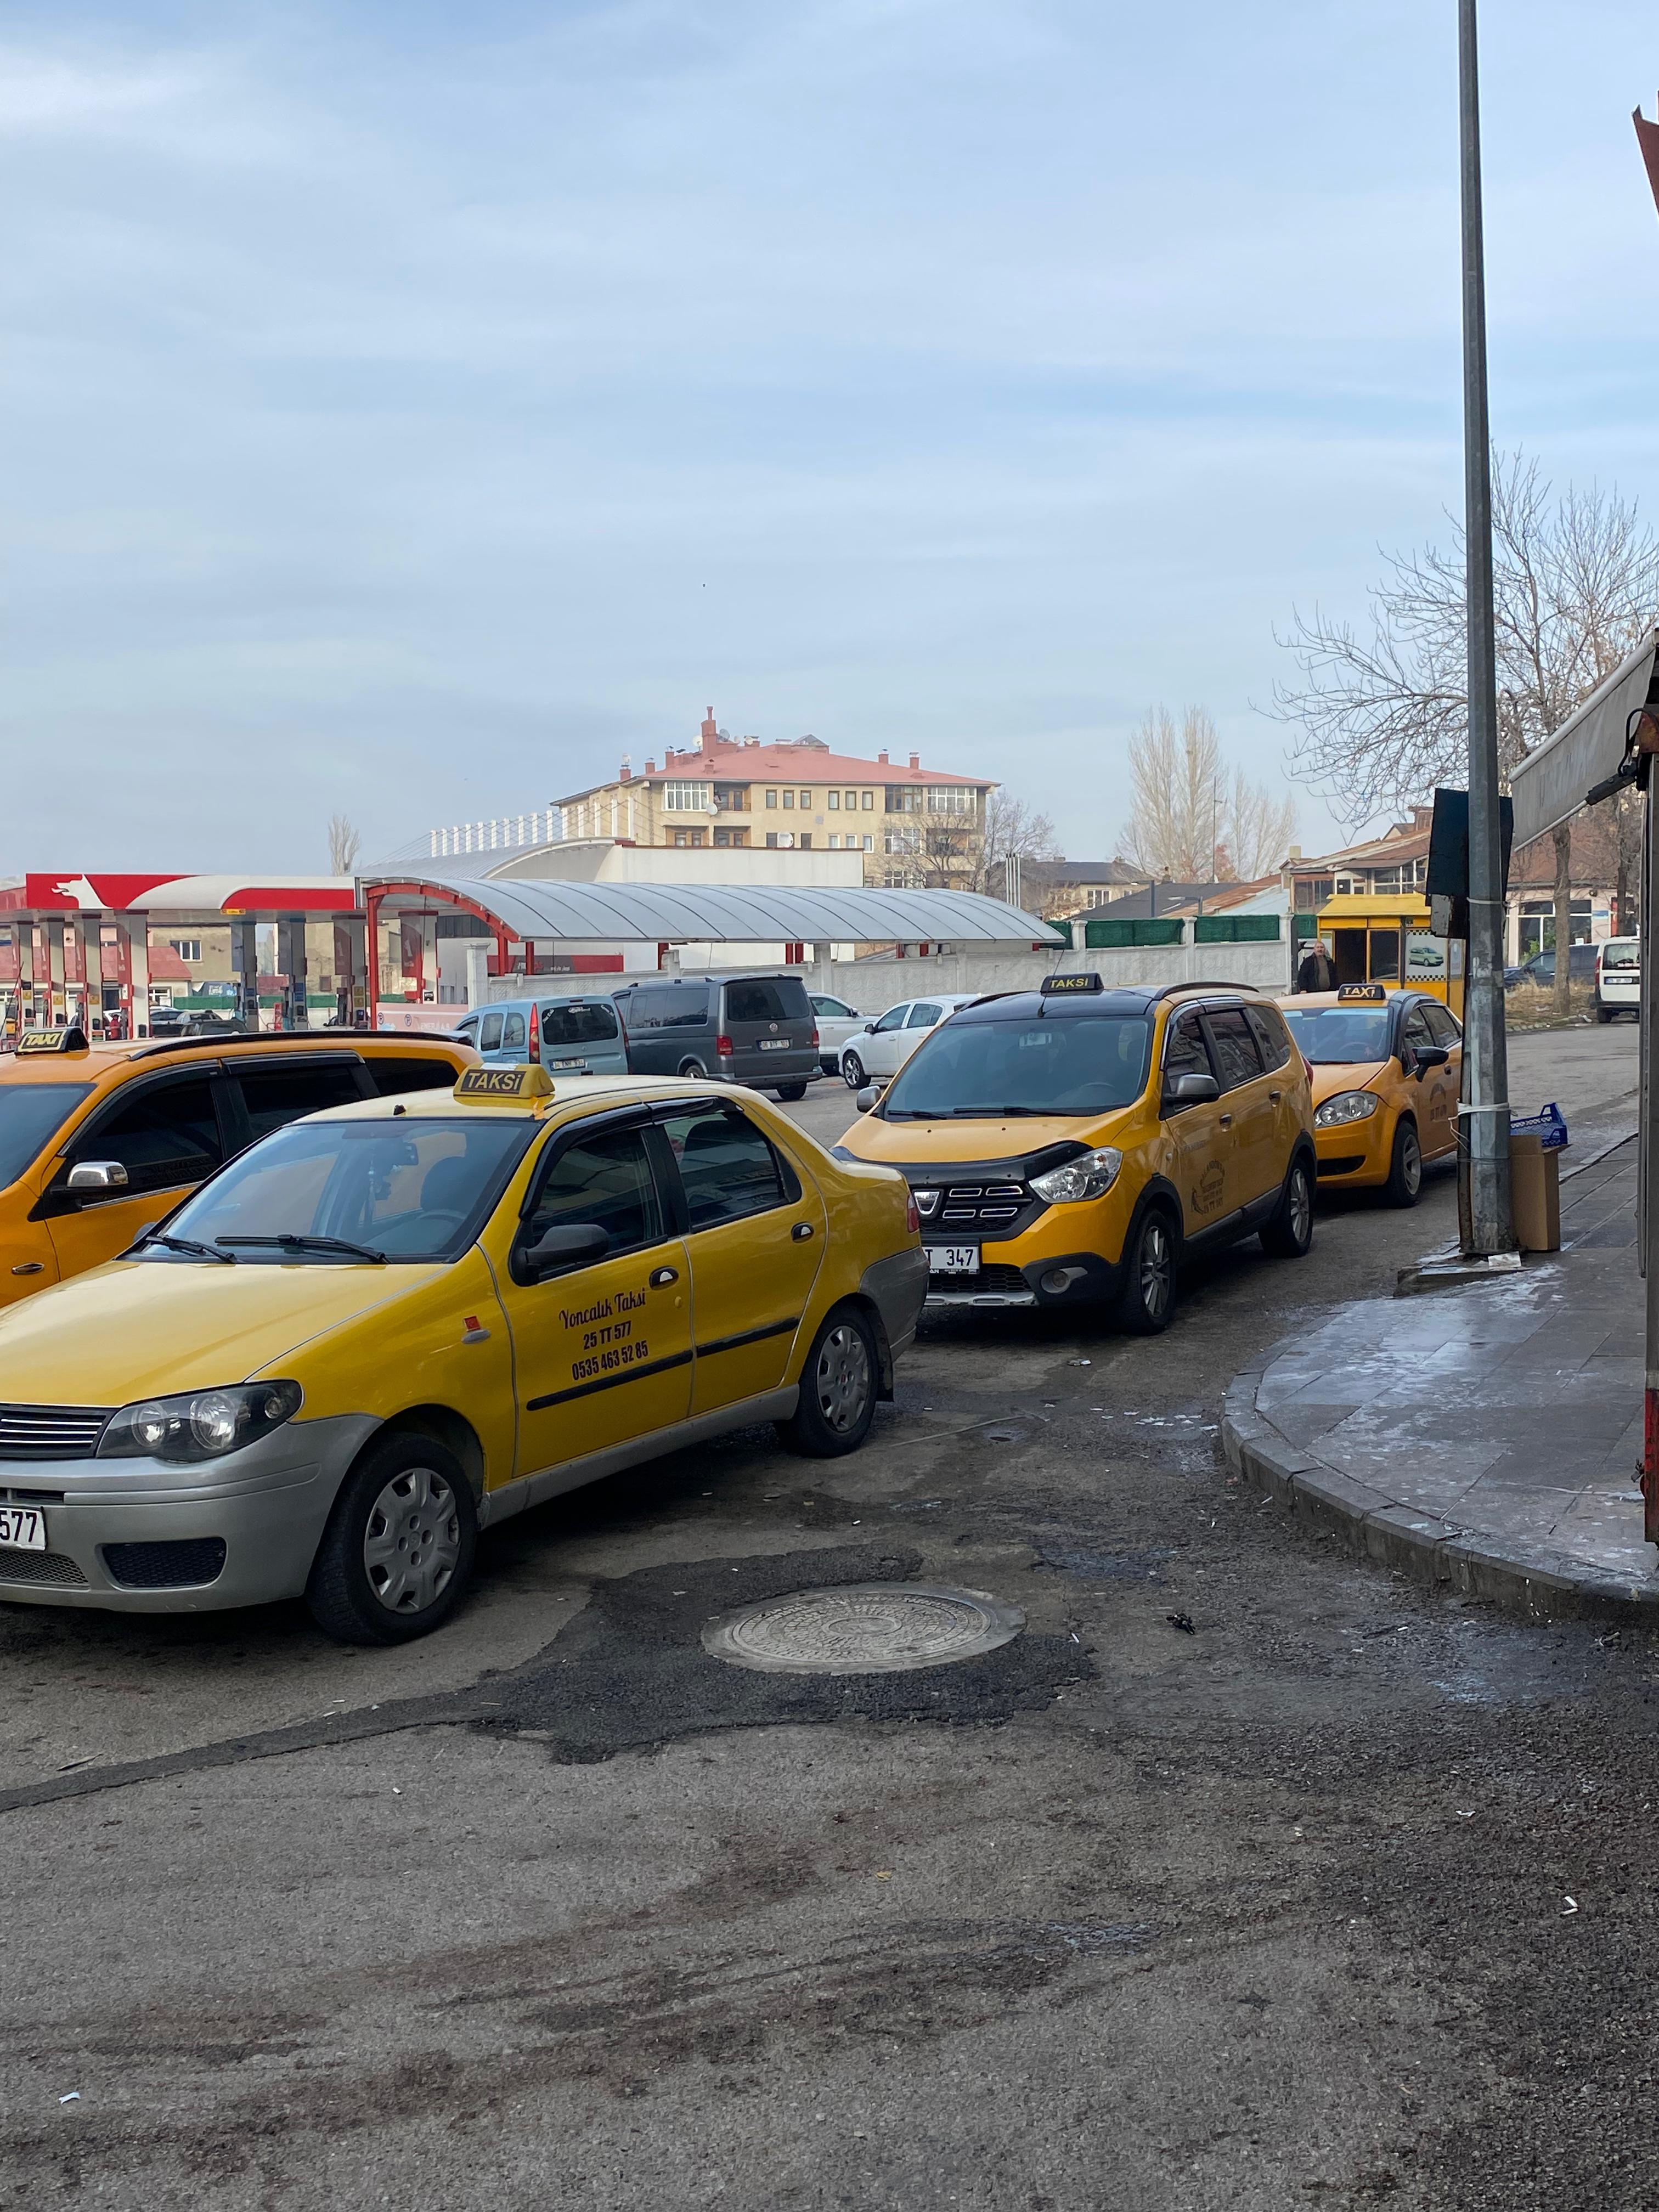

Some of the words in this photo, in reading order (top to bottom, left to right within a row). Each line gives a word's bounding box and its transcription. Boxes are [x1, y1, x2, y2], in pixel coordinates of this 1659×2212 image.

[1050, 978, 1088, 988] TAKSI
[1343, 986, 1375, 997] TAXI
[26, 1033, 61, 1046] TAXI
[946, 1249, 973, 1266] 347
[559, 1299, 613, 1329] Yoncalık
[614, 1287, 646, 1313] Taksi
[583, 1331, 597, 1350] 25
[600, 1327, 612, 1344] TT
[614, 1320, 631, 1340] 577
[572, 1356, 599, 1380] 0535
[601, 1349, 620, 1370] 463
[622, 1345, 634, 1363] 52
[635, 1340, 648, 1359] 85
[0, 1510, 37, 1543] 577
